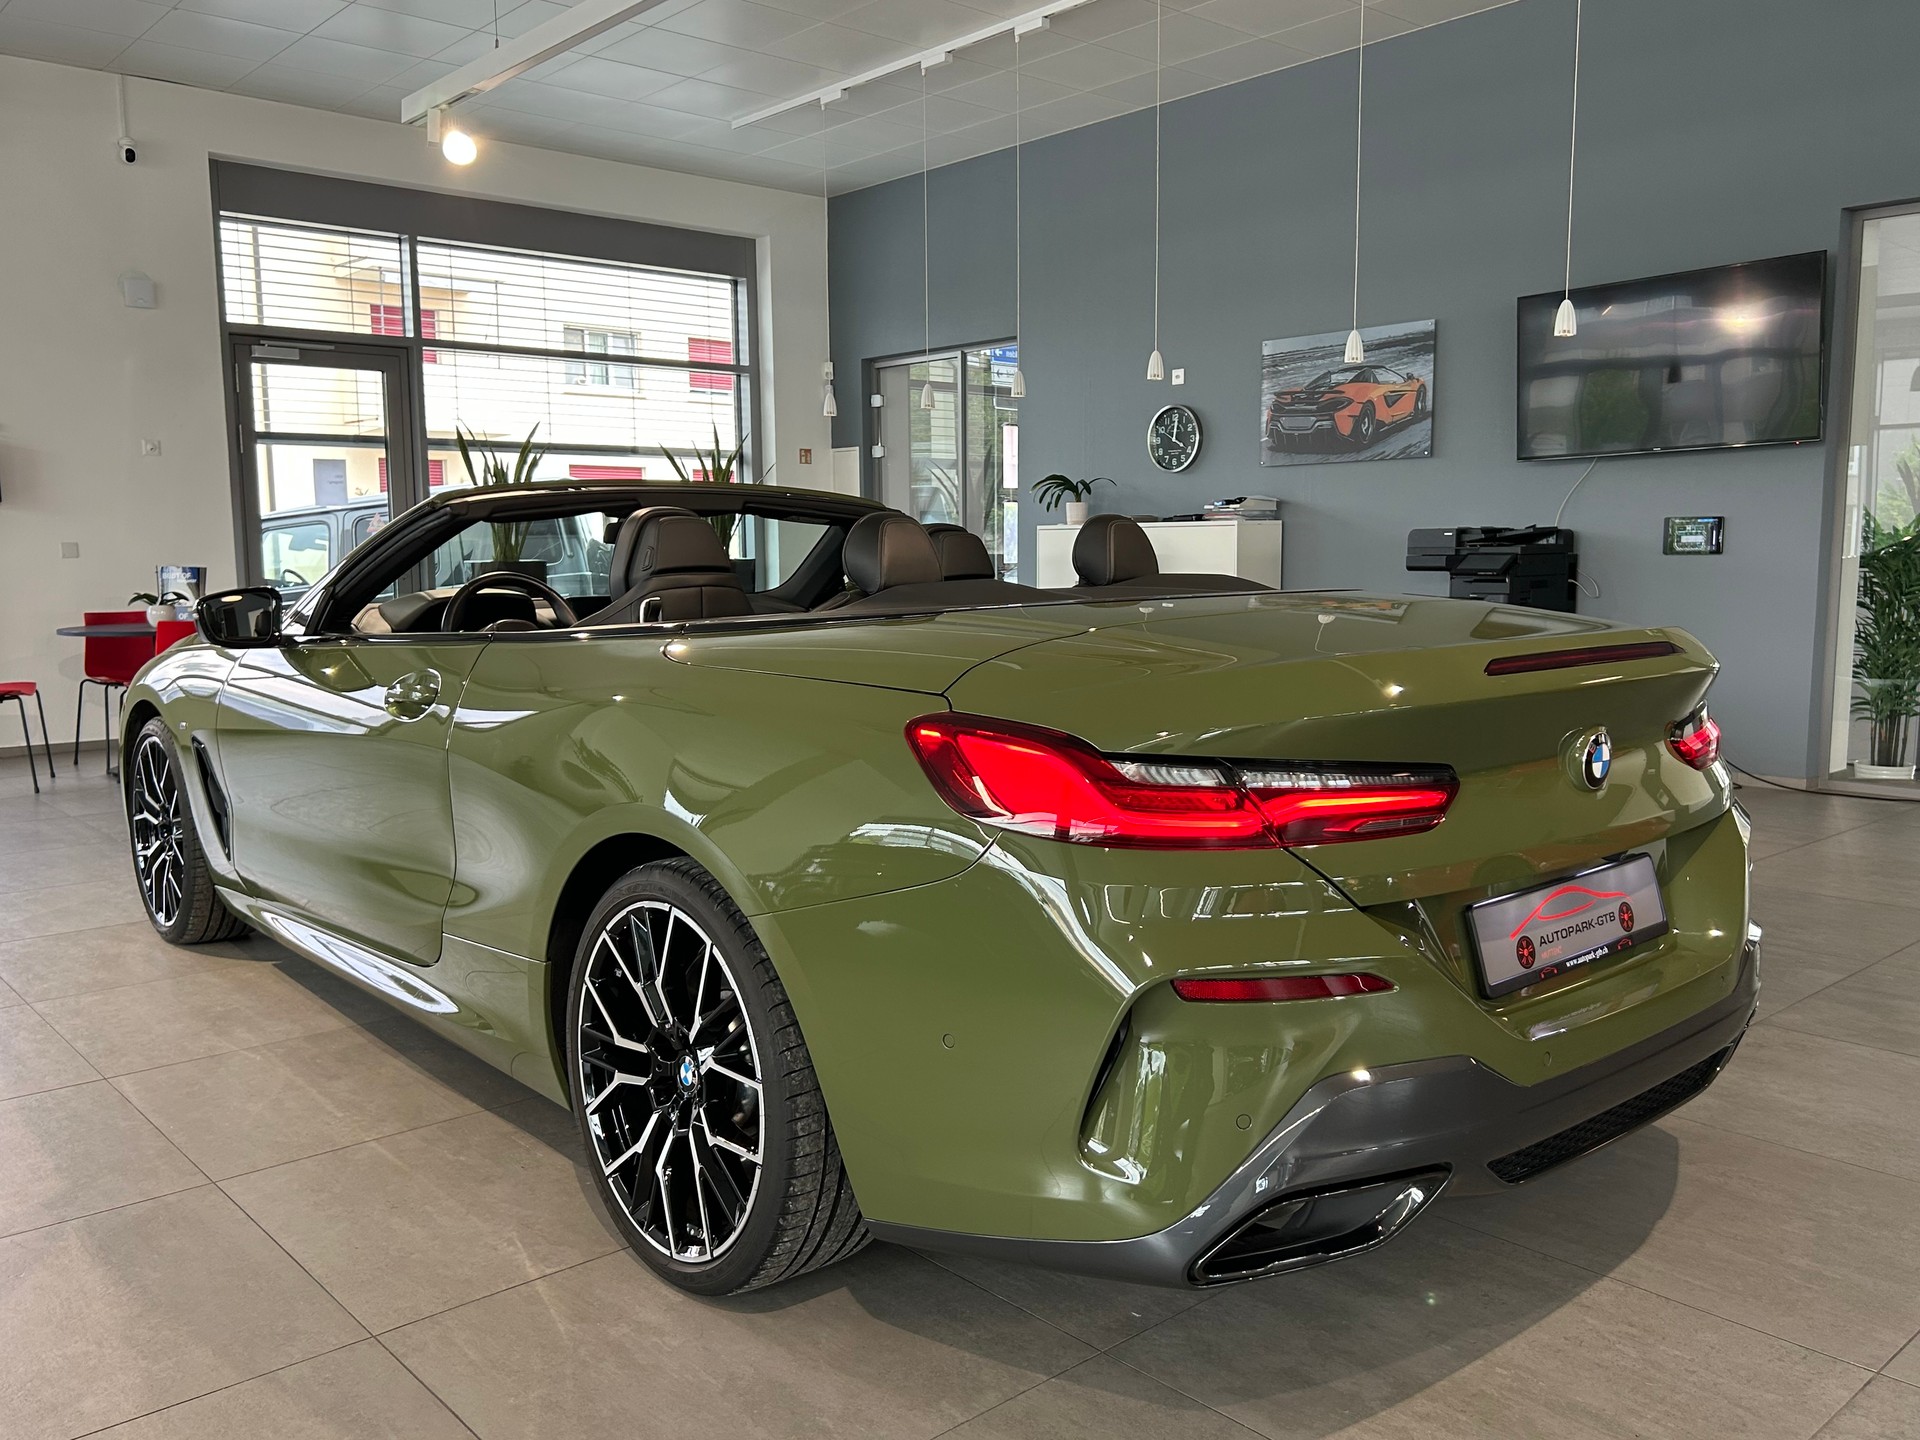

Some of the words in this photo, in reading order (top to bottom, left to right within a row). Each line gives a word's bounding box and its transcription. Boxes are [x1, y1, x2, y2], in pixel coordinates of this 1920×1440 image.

[1172, 413, 1179, 421] 12
[1187, 423, 1193, 431] 2
[1189, 434, 1195, 442] 3
[1158, 447, 1163, 455] 8
[1164, 455, 1169, 463] 7
[1180, 454, 1186, 462] 5
[1539, 911, 1616, 947] AUTOPARK-GTB
[1565, 946, 1609, 967] www.autopark-gtb.ch
